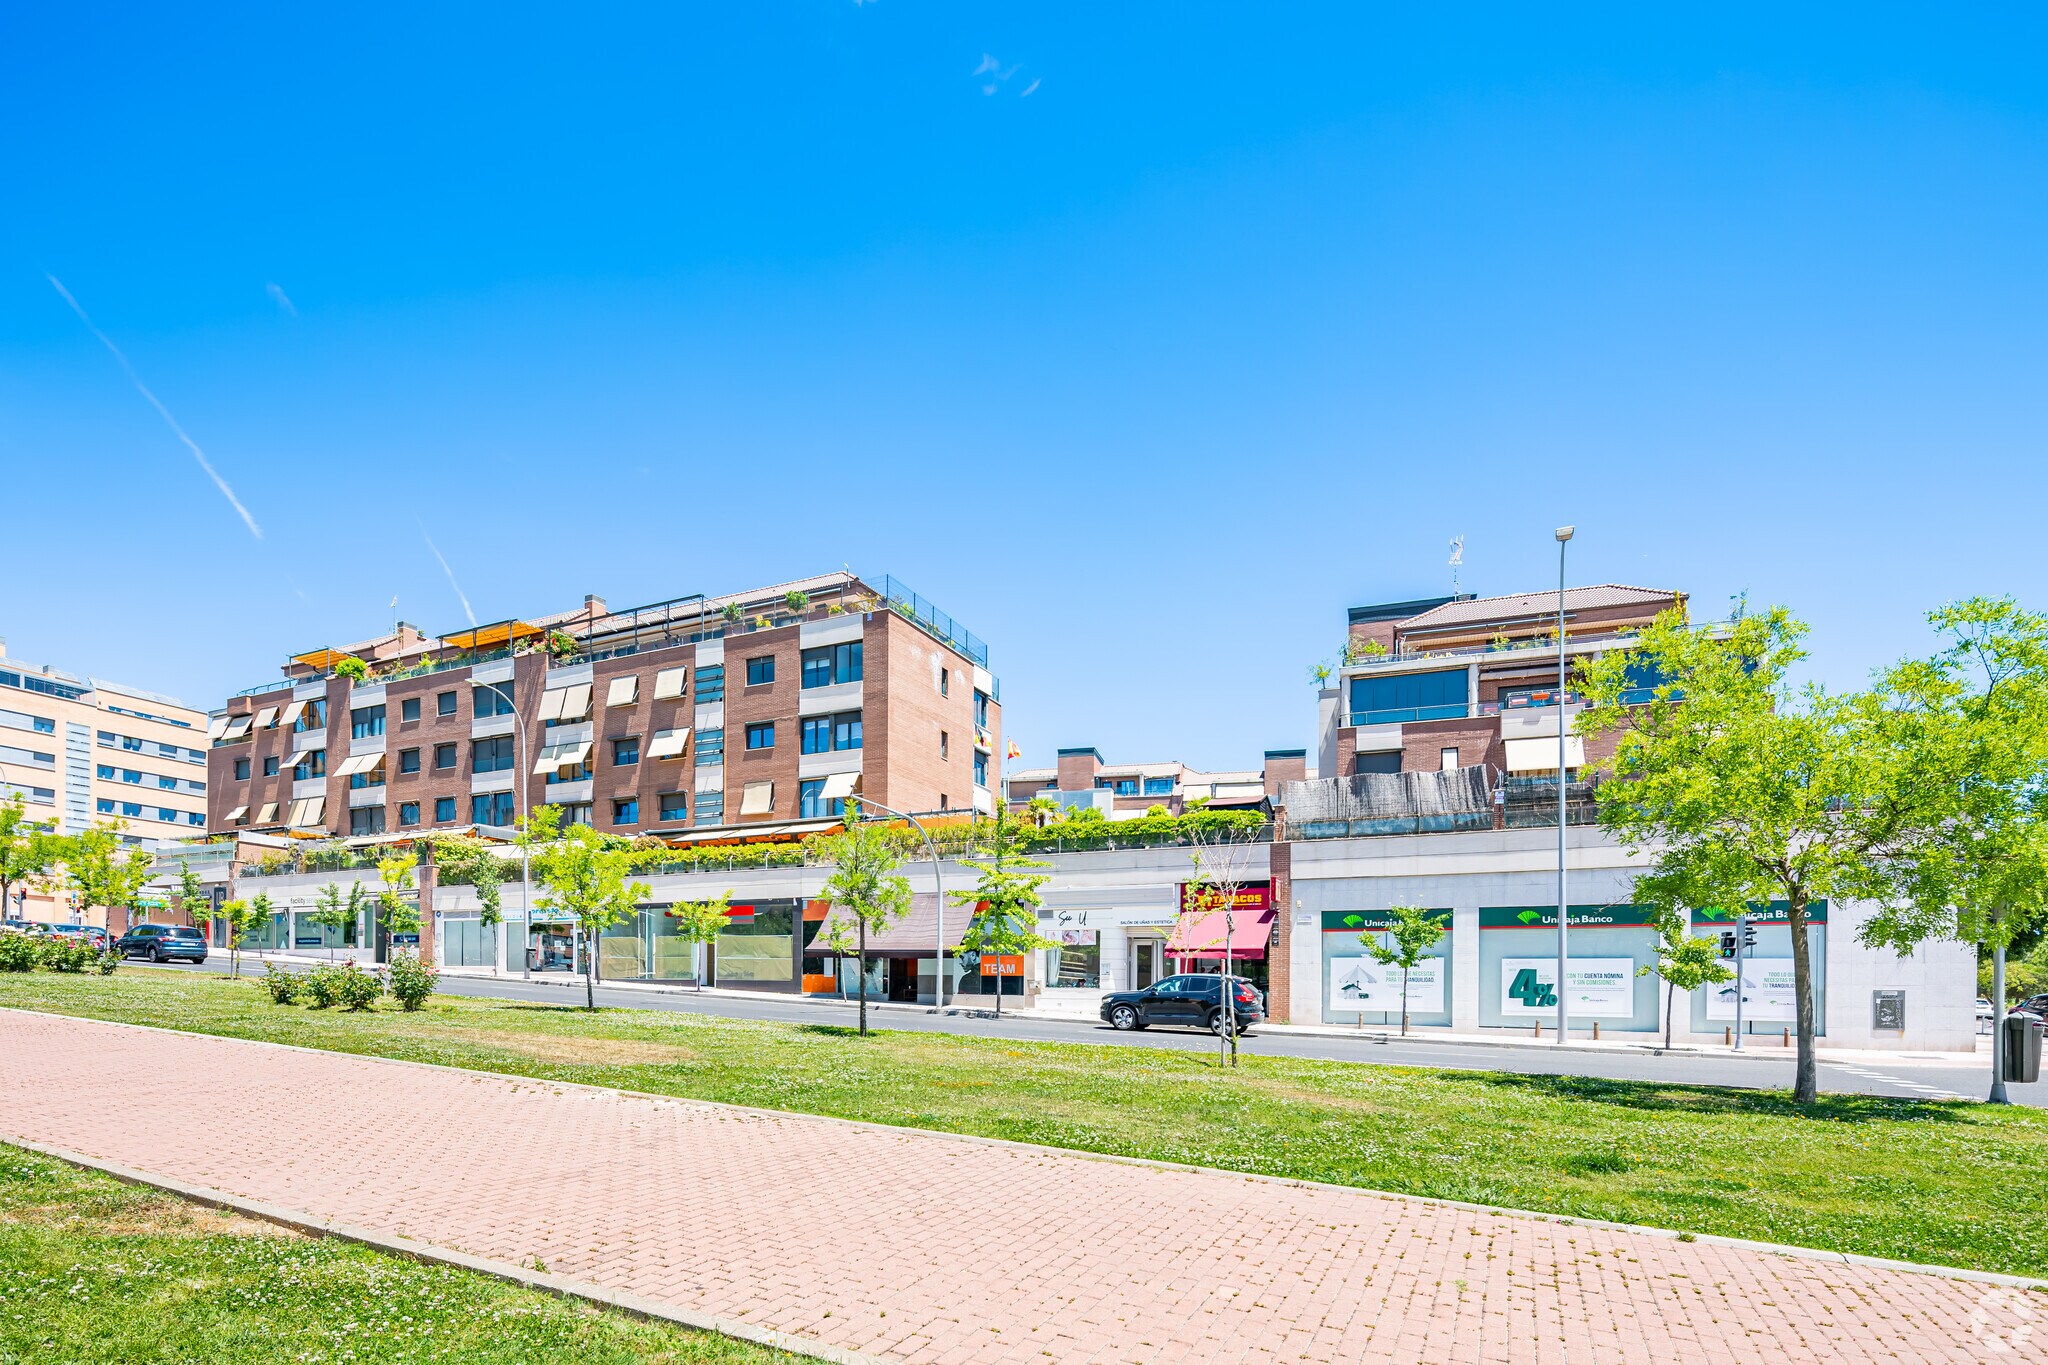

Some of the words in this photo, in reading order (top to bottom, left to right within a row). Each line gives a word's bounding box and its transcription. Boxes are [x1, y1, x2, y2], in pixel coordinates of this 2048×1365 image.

[1078, 911, 1087, 926] U
[1775, 910, 1812, 919] Bao
[1542, 915, 1581, 925] Uniaja
[1581, 915, 1613, 923] Banco
[984, 964, 1016, 974] TEAM
